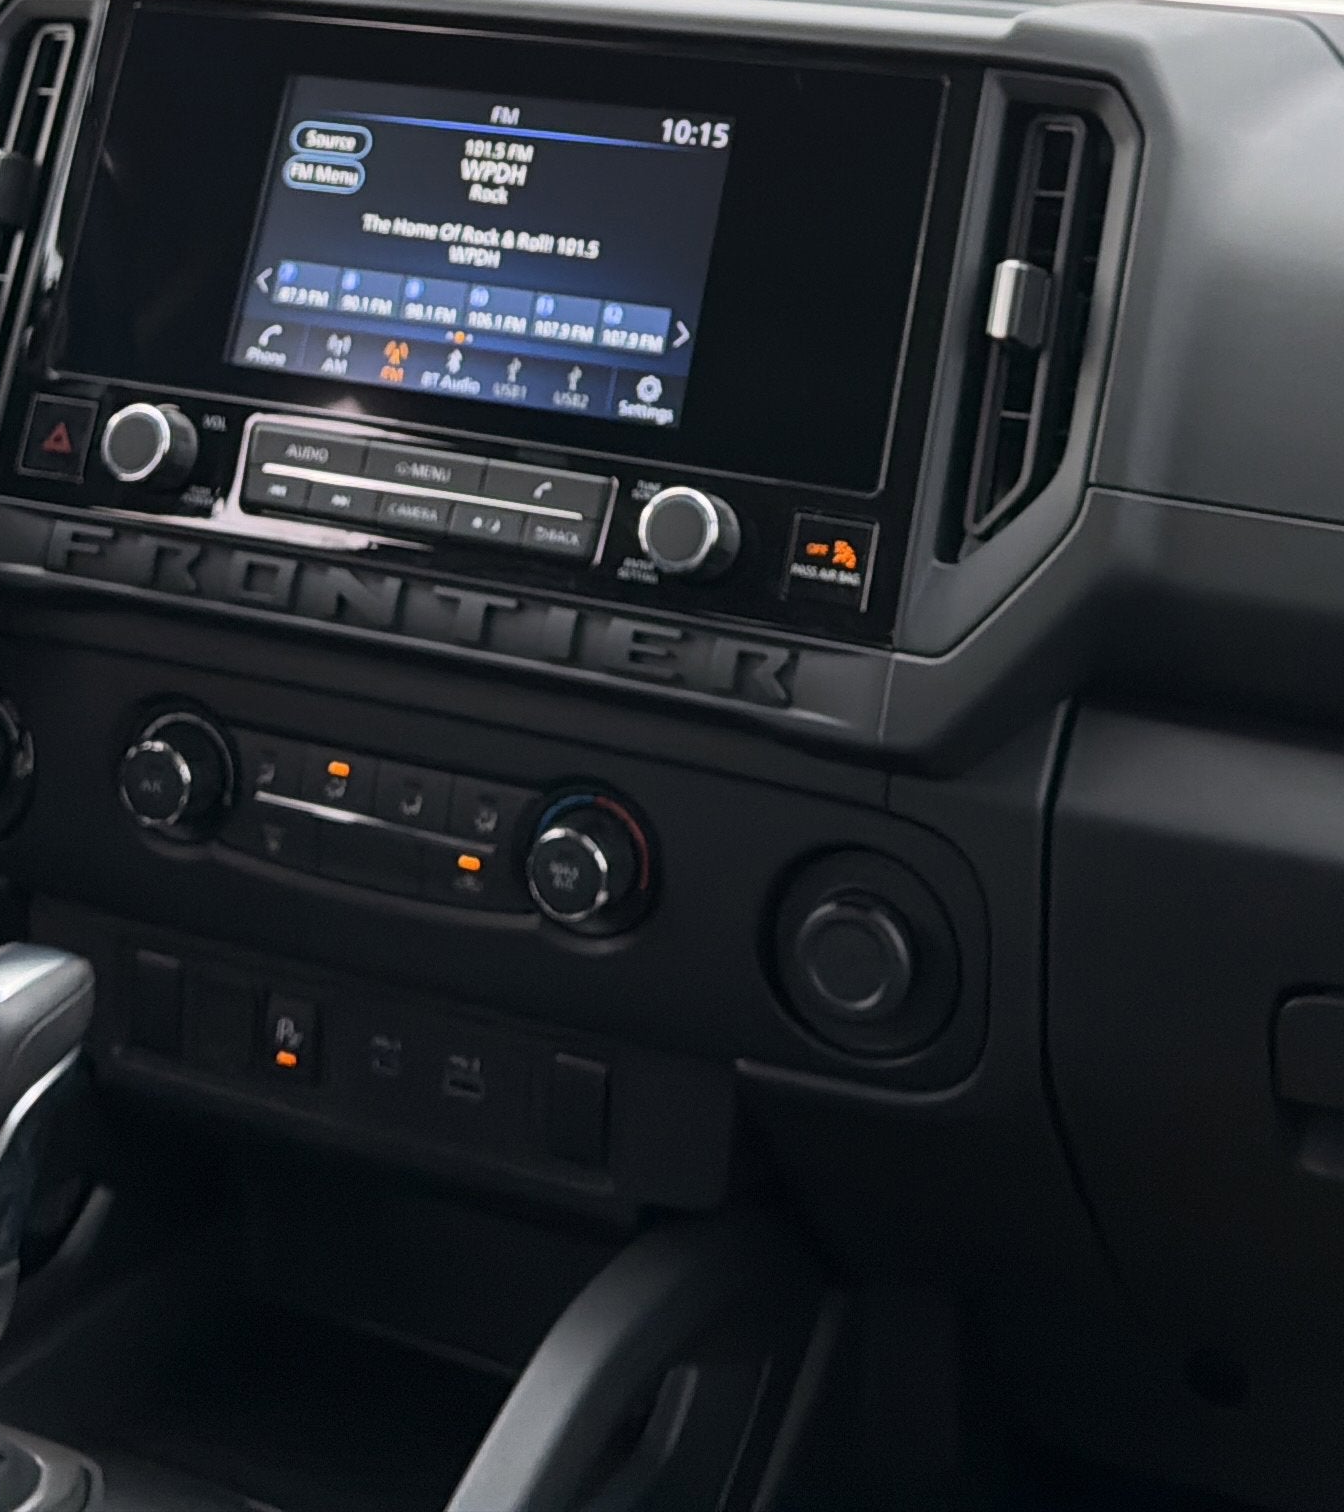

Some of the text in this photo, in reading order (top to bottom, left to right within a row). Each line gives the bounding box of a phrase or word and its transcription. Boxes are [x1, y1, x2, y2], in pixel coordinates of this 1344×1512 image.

[490, 105, 520, 126] FM
[305, 128, 356, 152] Source
[661, 117, 731, 149] 10:15
[464, 139, 534, 164] 101.5 FM
[289, 162, 359, 187] FM Menu
[460, 158, 528, 186] WPDH
[468, 183, 509, 205] Rock
[362, 212, 391, 236] The
[392, 217, 438, 241] Home
[439, 222, 461, 243] Of
[462, 225, 500, 249] Rock
[556, 236, 601, 260] 101.5
[448, 245, 501, 269] WPDH
[244, 346, 287, 368] Phone
[320, 357, 348, 376] AM
[440, 374, 482, 396] Audio
[284, 443, 330, 464] AUDIO
[410, 462, 453, 485] MENU
[42, 518, 793, 707] FRONTIER
